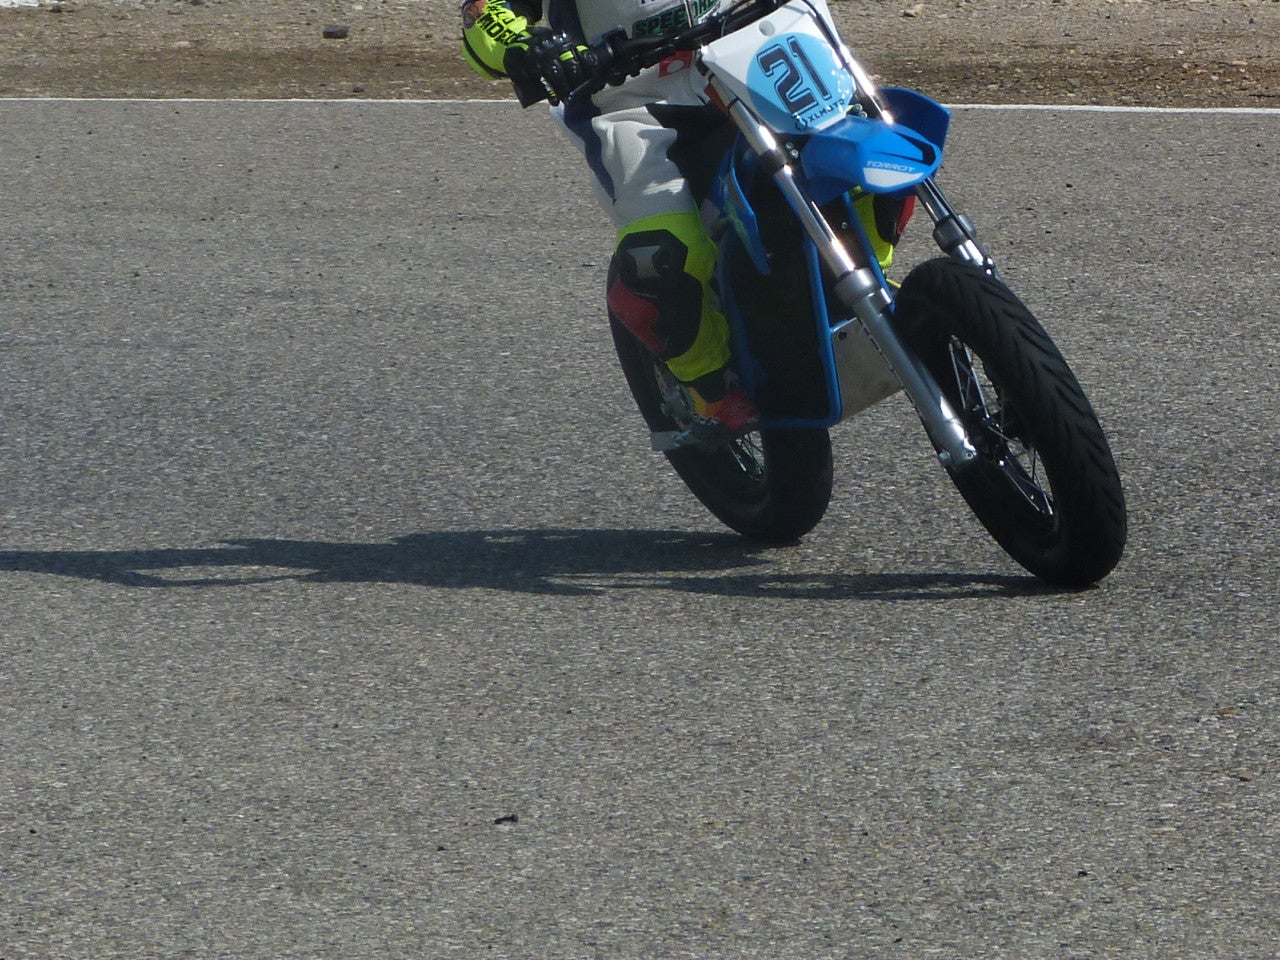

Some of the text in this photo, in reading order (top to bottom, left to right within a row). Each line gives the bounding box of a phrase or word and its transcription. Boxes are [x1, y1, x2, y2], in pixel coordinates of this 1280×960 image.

[757, 35, 832, 117] 21
[807, 98, 845, 122] XLMOTO
[866, 160, 916, 172] TORROT
